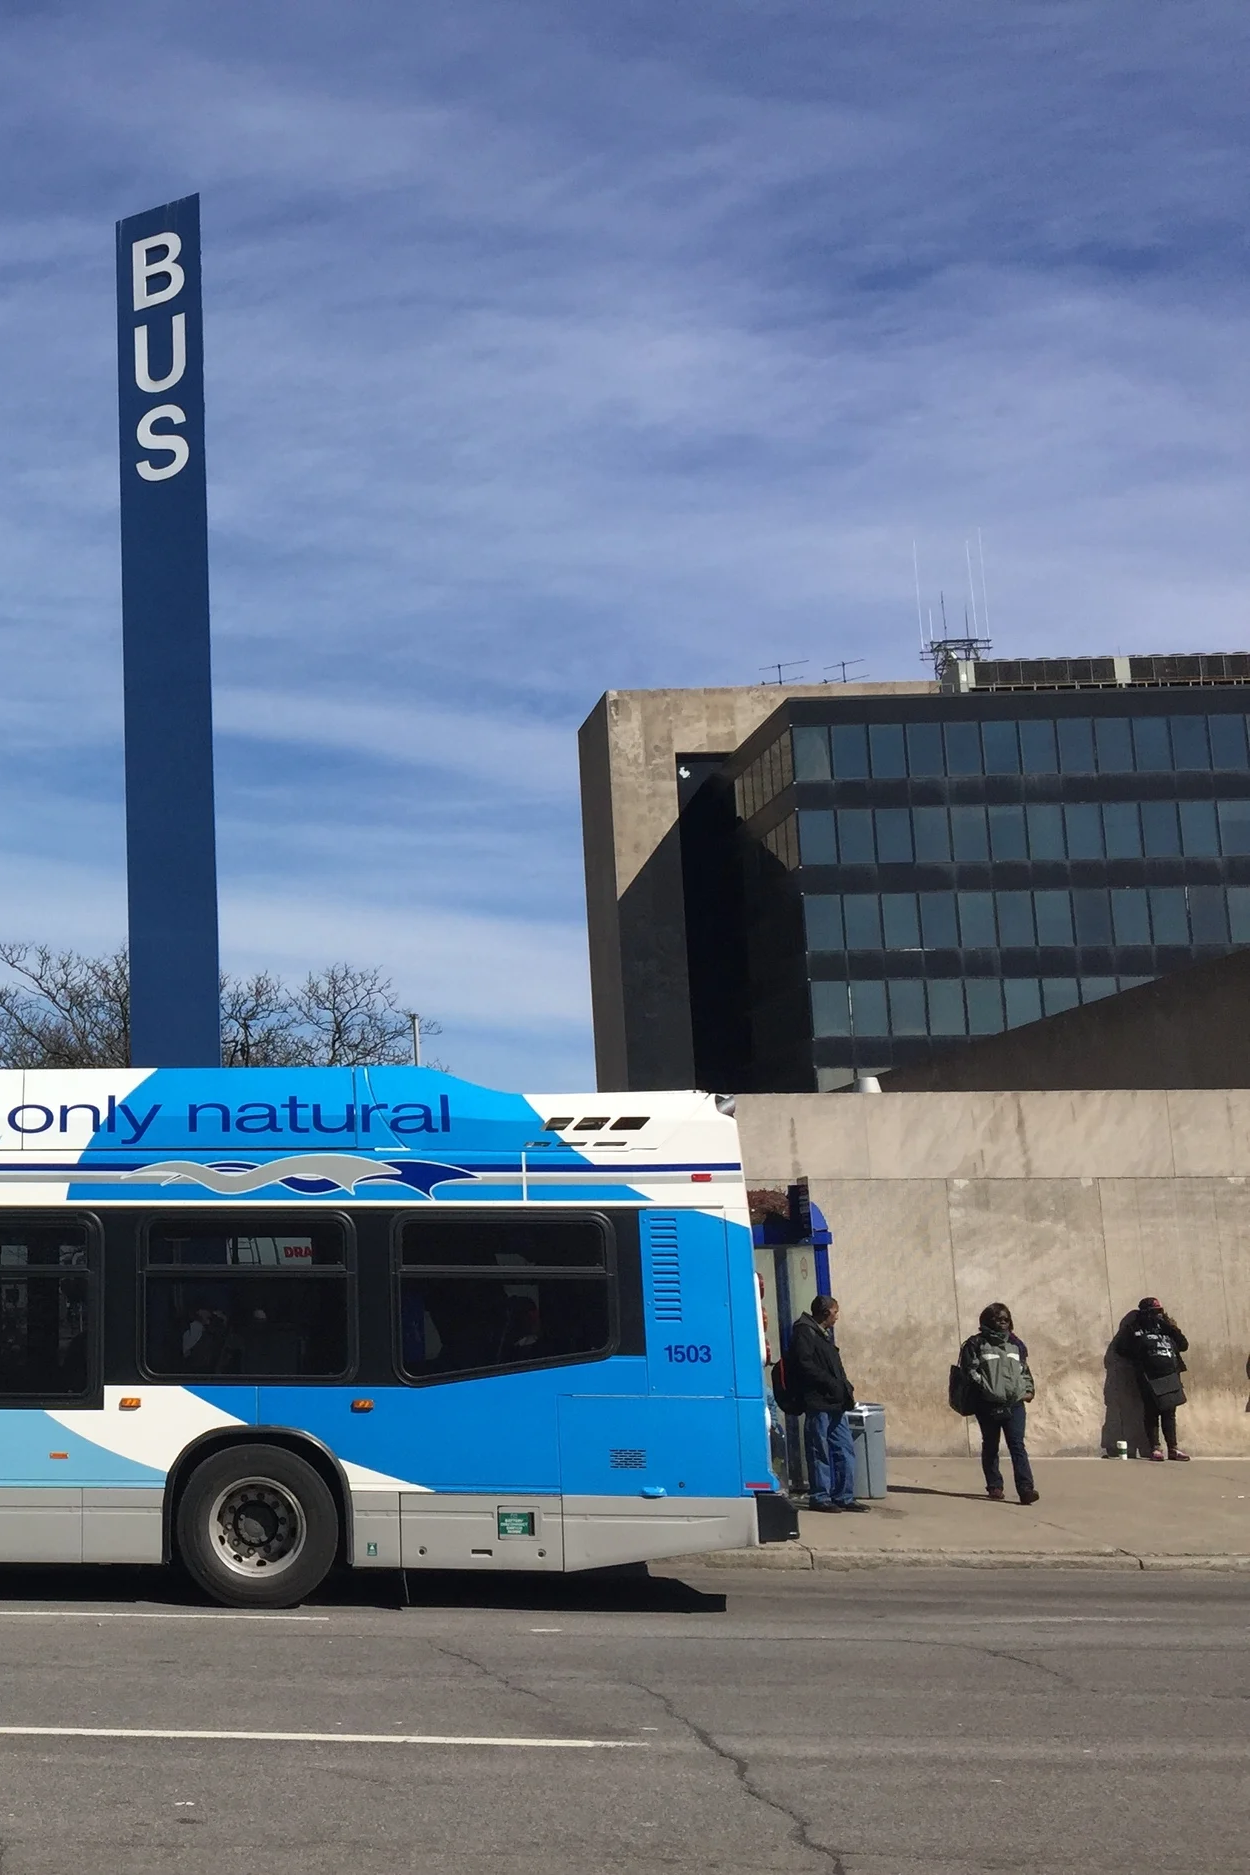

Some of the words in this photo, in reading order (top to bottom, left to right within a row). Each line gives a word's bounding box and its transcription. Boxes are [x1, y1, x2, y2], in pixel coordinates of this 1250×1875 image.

[132, 231, 190, 482] BUS
[7, 1095, 163, 1145] only
[188, 1094, 451, 1134] natural
[664, 1344, 712, 1363] 1503
